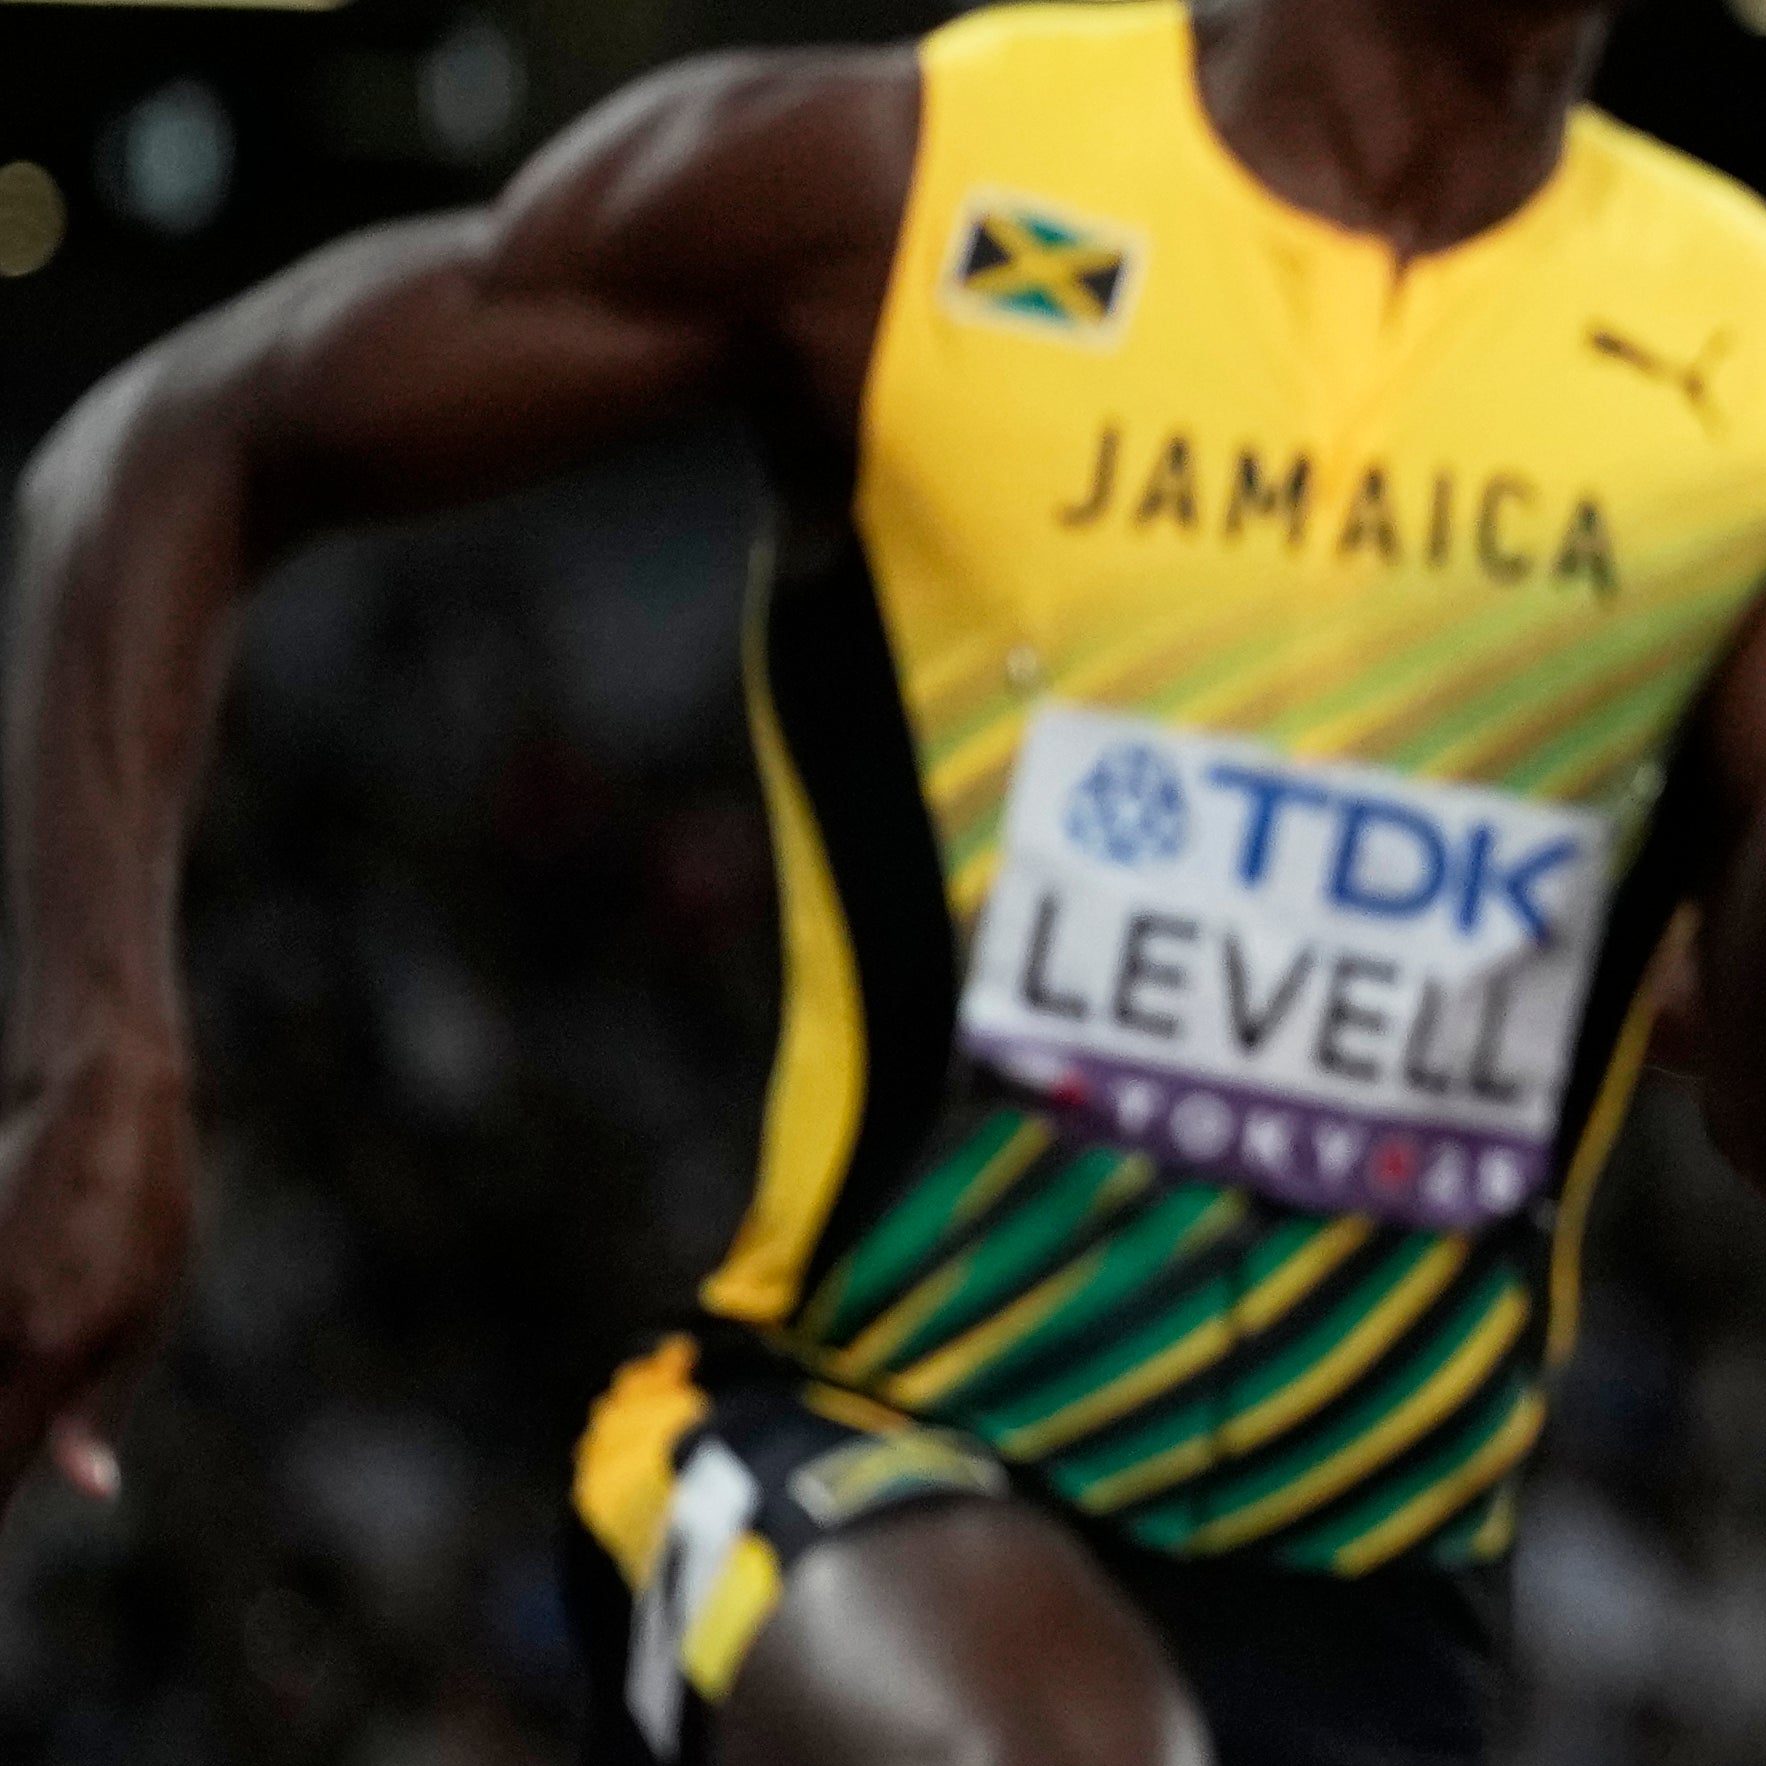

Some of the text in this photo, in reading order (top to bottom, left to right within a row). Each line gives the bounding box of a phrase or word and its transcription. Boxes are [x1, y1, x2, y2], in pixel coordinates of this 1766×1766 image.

[1055, 419, 1623, 596] JAMAICA
[1205, 761, 1581, 947] TDK
[1016, 891, 1522, 1101] LEVELL
